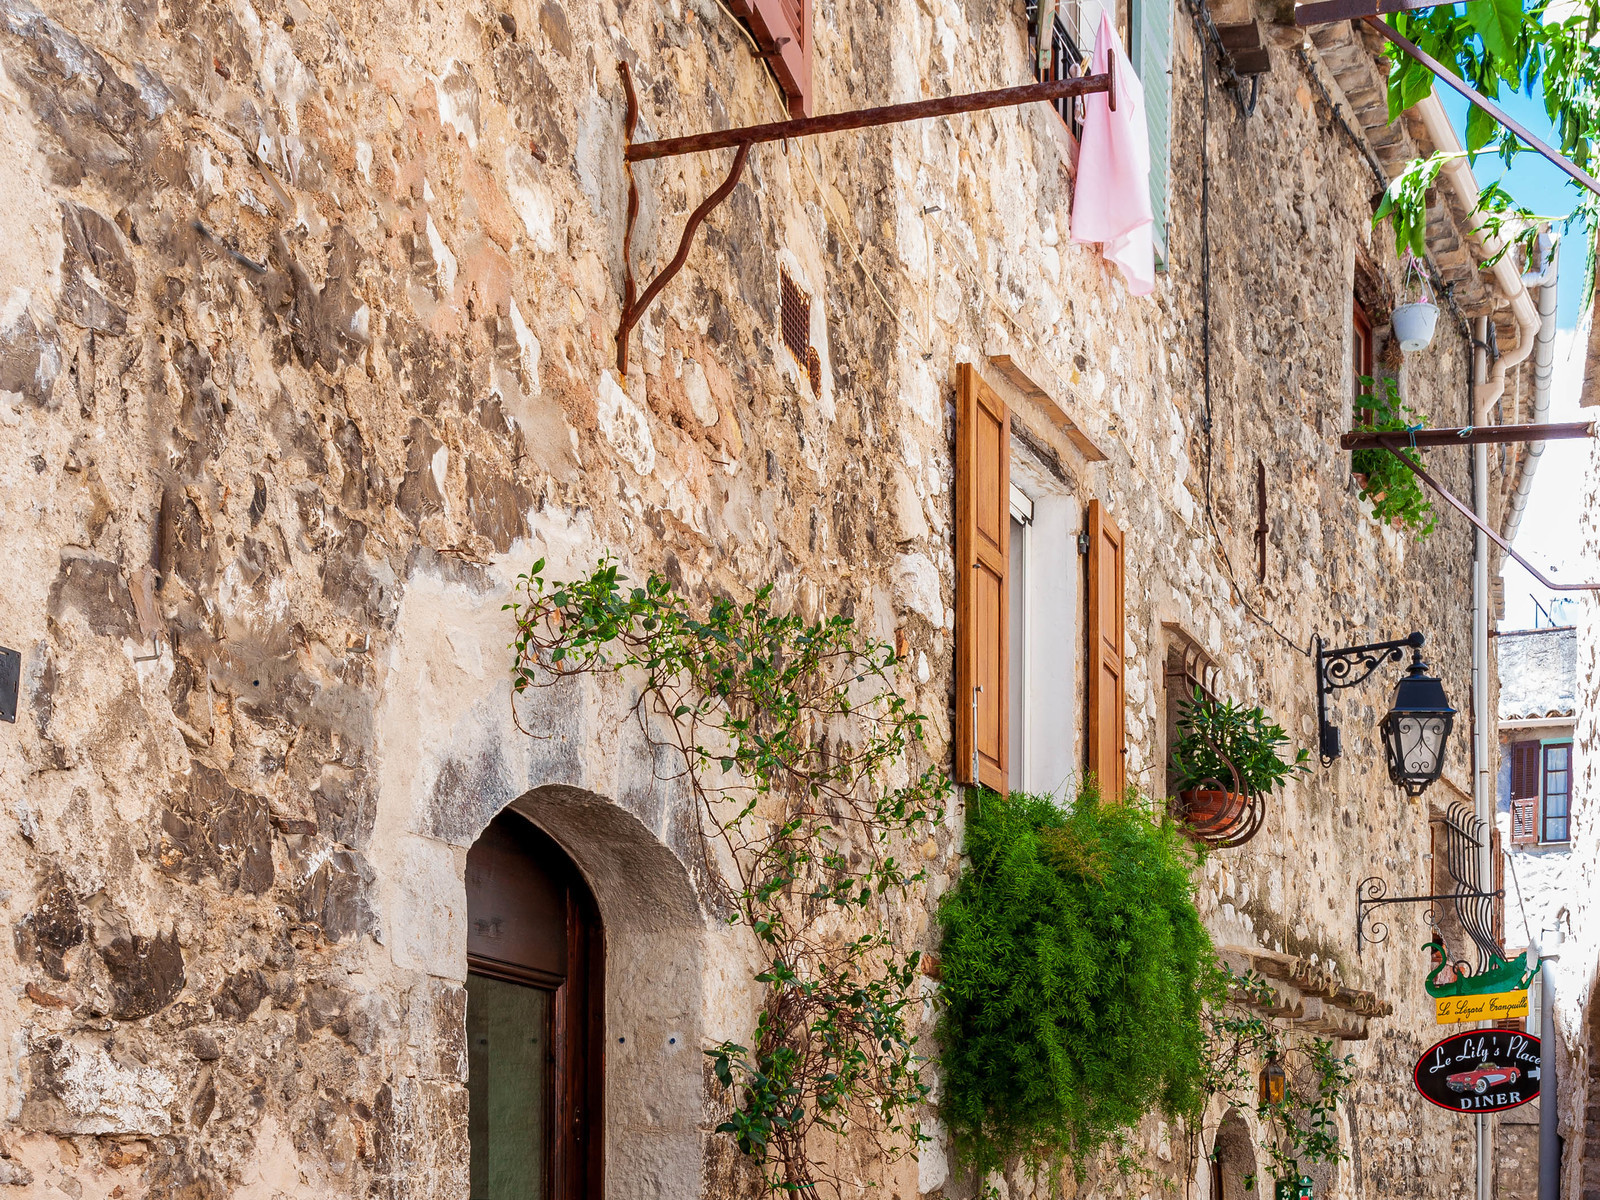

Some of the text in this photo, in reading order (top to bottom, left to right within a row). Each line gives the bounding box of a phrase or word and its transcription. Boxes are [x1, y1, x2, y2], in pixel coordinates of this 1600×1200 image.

[1438, 1002, 1451, 1016] Le
[1455, 1000, 1485, 1018] Lézard
[1429, 1035, 1540, 1073] Le Lily's Place
[1461, 1091, 1521, 1110] DINER
